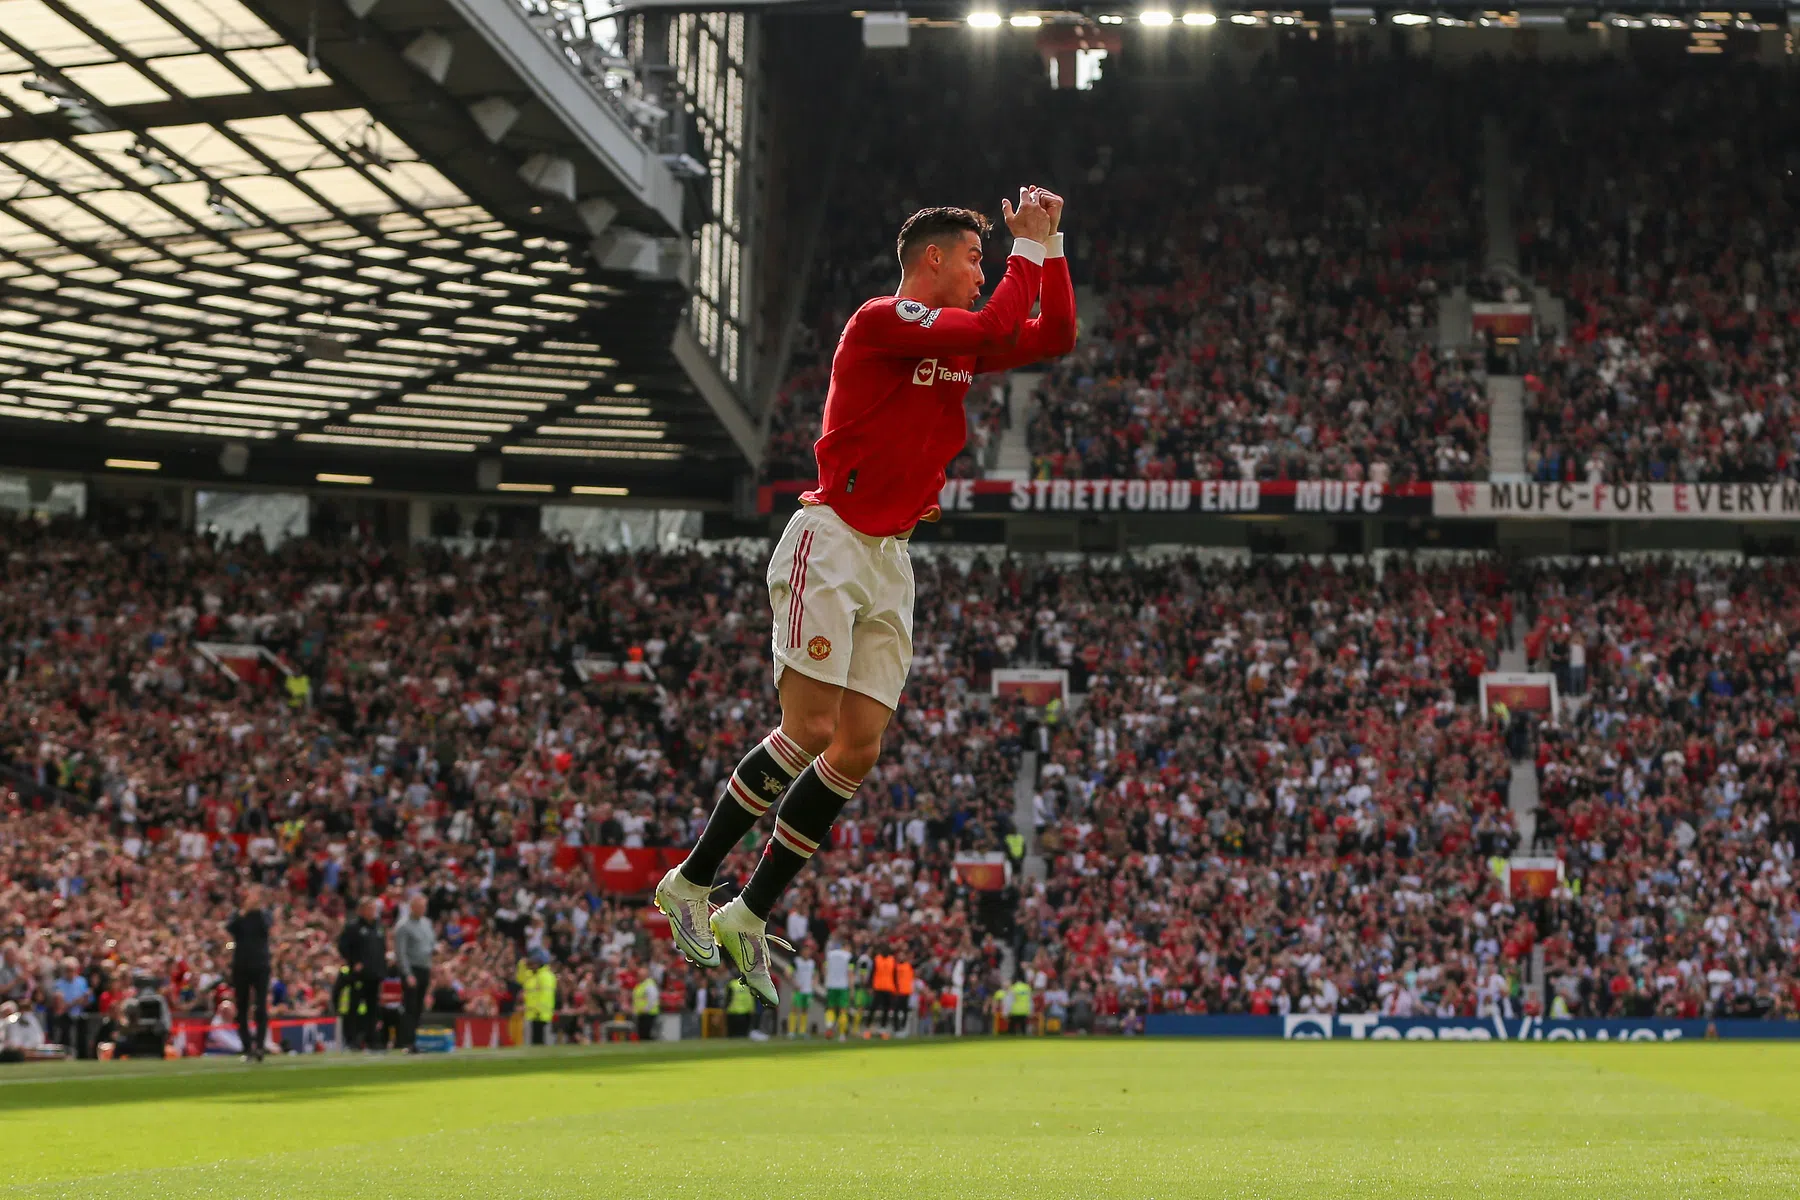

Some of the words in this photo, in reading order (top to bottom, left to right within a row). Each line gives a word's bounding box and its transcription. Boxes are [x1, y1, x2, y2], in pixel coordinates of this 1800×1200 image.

[1010, 480, 1192, 511] STRETFORD
[1201, 480, 1260, 511] END
[1295, 480, 1383, 512] MUFC
